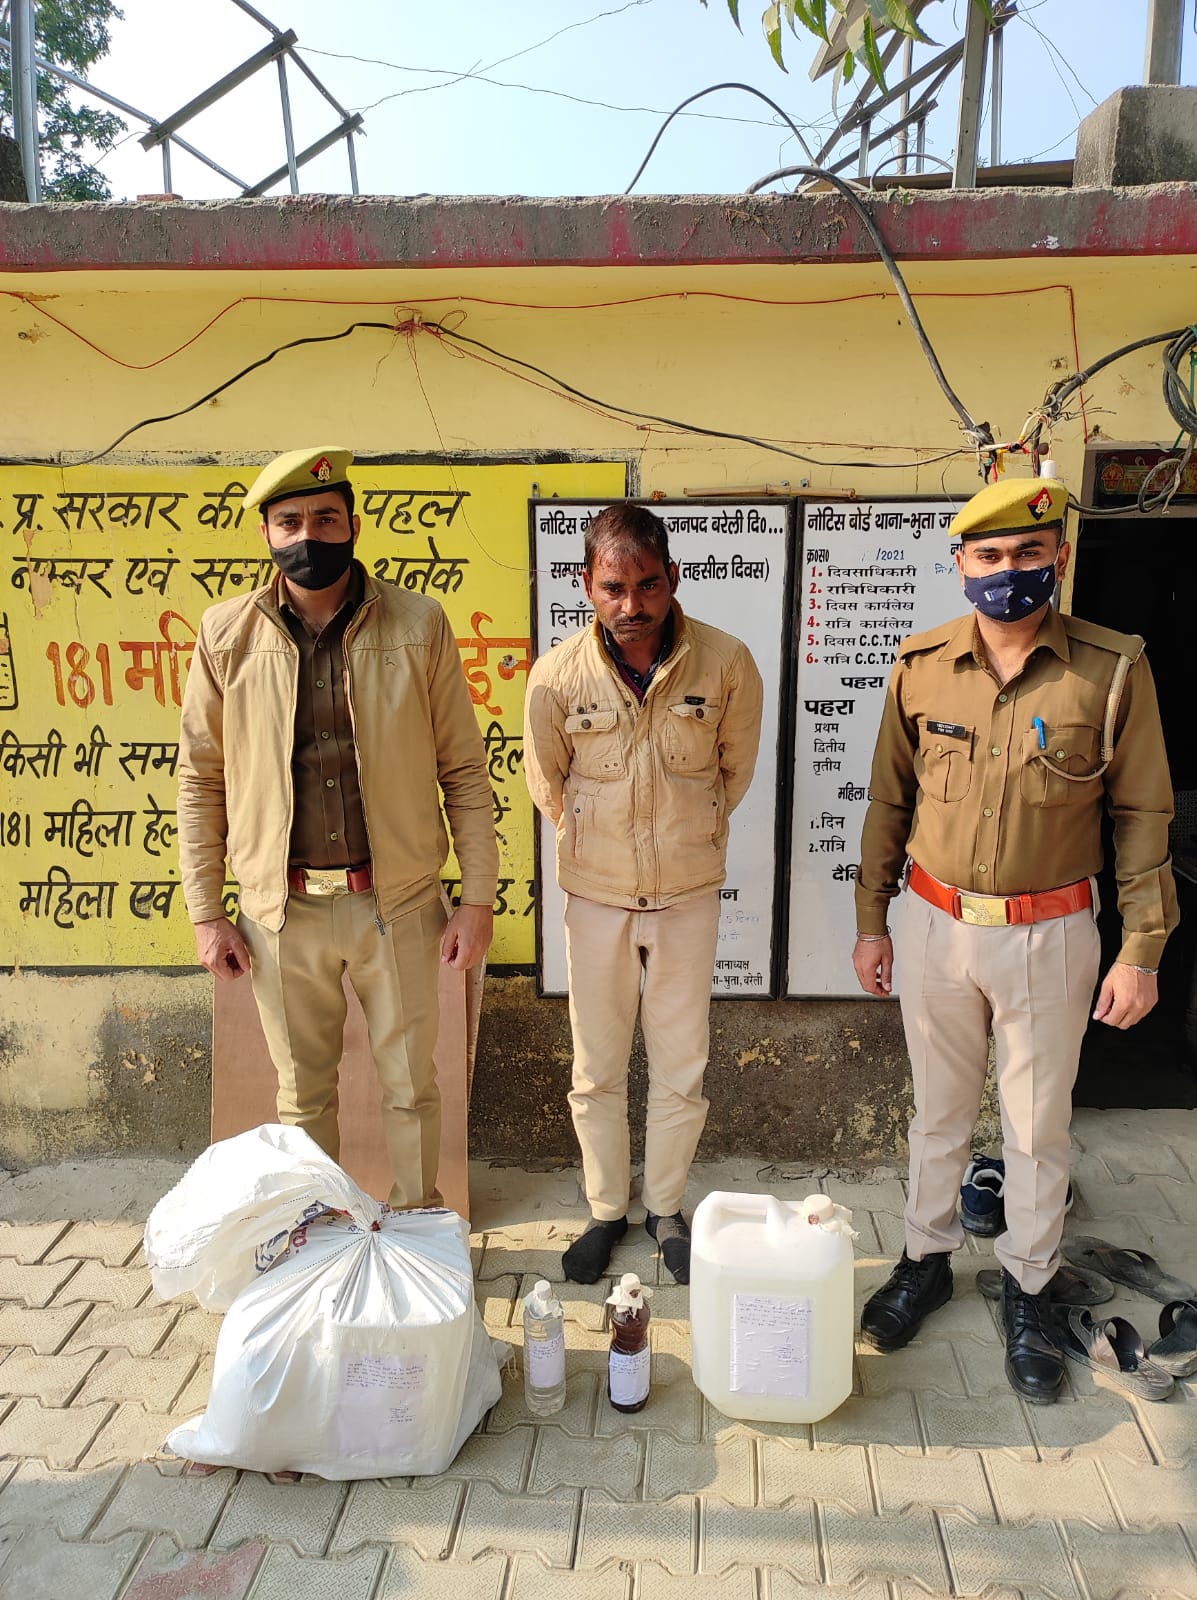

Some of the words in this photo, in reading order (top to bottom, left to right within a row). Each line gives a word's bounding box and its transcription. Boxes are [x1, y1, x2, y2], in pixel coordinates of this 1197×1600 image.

[53, 493, 188, 533] सरकार
[363, 490, 471, 534] पहल
[540, 510, 577, 535] नोटिस
[667, 516, 709, 533] जनपद
[808, 507, 846, 531] नोटिस
[849, 505, 872, 532] बोर्ड
[875, 512, 936, 539] थाना-भुता
[125, 548, 181, 596] एवं
[678, 555, 729, 582] (तहसील
[731, 554, 769, 582] दिवस)
[811, 566, 823, 578] 1.
[827, 565, 917, 578] दिवसाधिकारी
[809, 582, 822, 594] 2.
[809, 598, 822, 610] 3.
[826, 599, 857, 611] दिवस
[807, 616, 820, 628] 4.
[825, 617, 852, 629] रात्रि
[807, 634, 819, 646] 5.
[824, 635, 856, 646] दिवस
[806, 652, 819, 664] 6.
[823, 652, 850, 665] रात्रि
[46, 641, 113, 708] 181
[840, 676, 884, 689] पहरा
[804, 699, 855, 716] पहरा
[814, 723, 839, 733] प्रथम
[0, 729, 67, 779] किसी
[74, 724, 112, 777] भी
[814, 738, 846, 753] द्वितीय
[813, 757, 841, 775] तृतीय
[838, 781, 866, 801] महिला
[0, 810, 31, 848] 181
[44, 798, 136, 857] महिला
[19, 865, 119, 928] महिला
[130, 869, 181, 919] एवं
